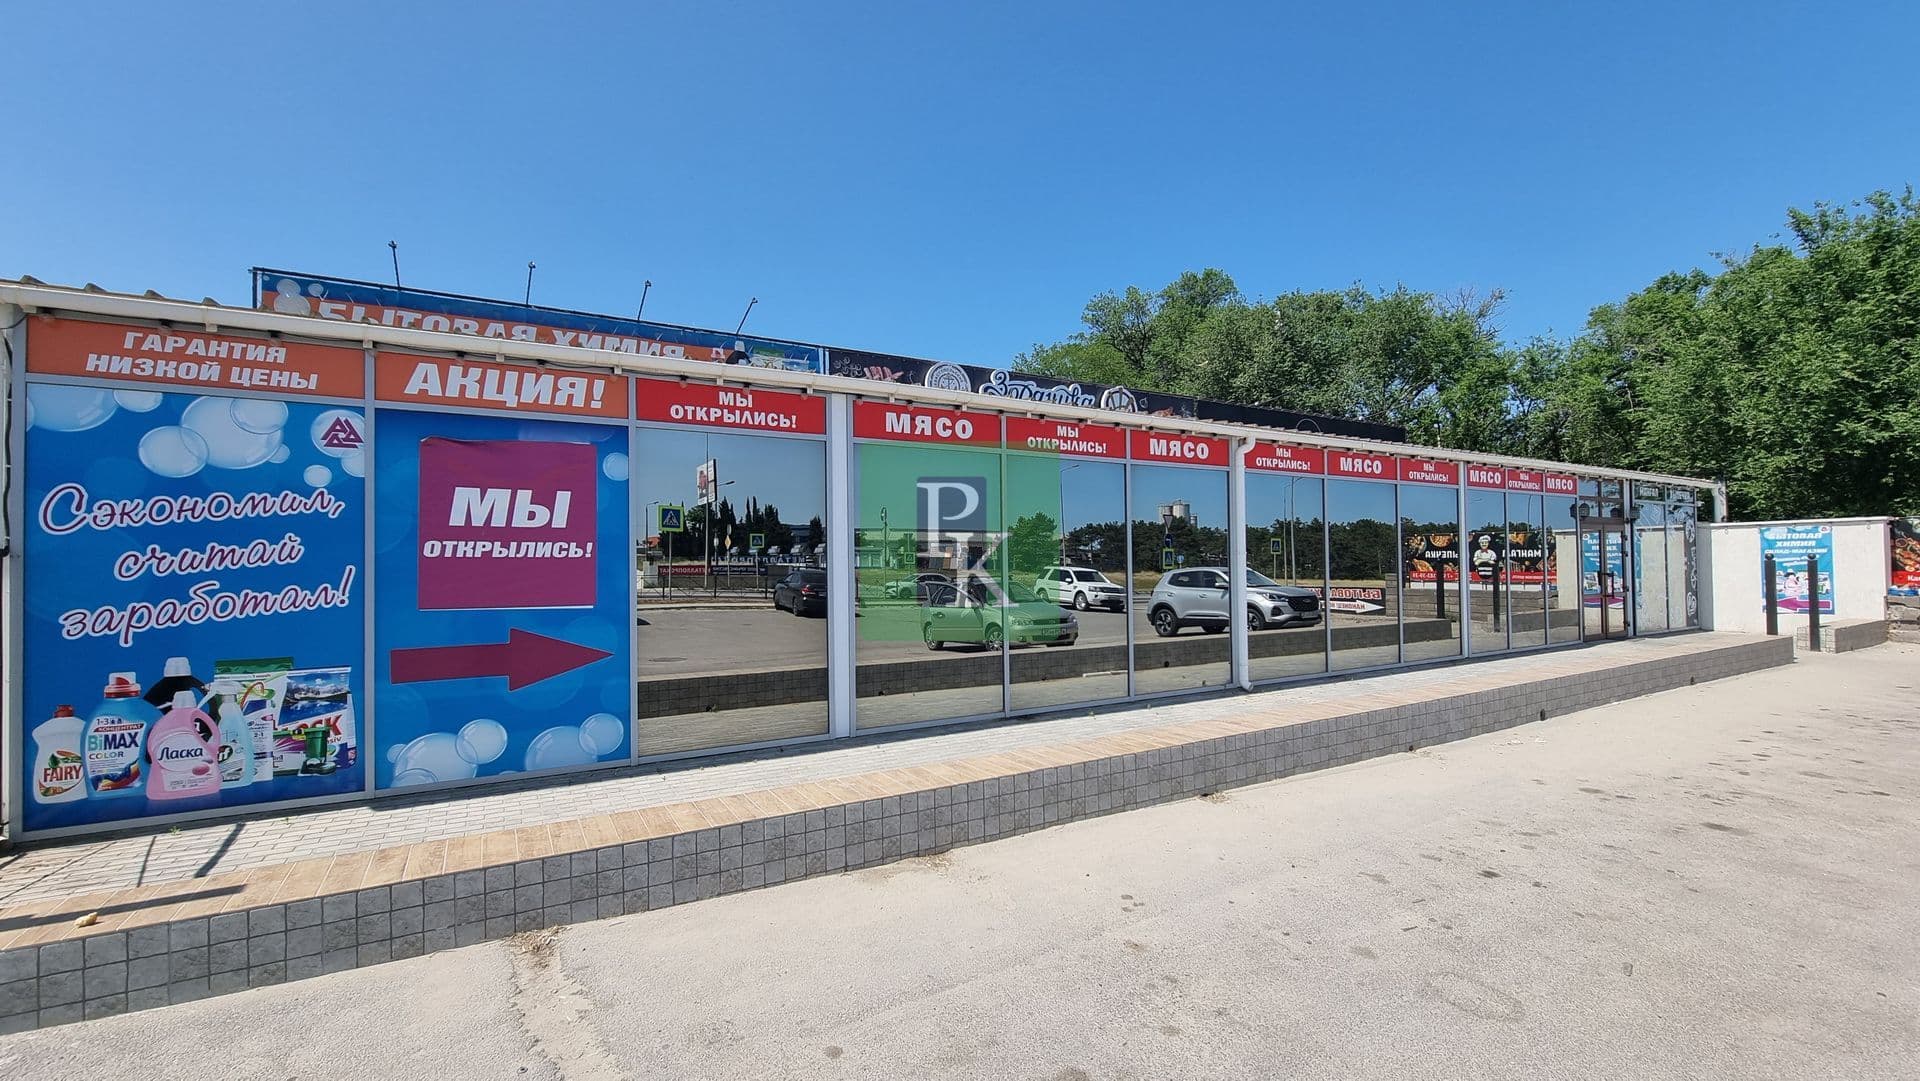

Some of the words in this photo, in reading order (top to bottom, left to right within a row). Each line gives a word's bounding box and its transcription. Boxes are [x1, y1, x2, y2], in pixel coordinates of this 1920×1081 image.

[123, 331, 287, 363] ГАРАНТИЯ
[86, 354, 221, 383] НИЗКОЙ
[230, 366, 318, 390] ЦЕНЫ
[404, 362, 606, 409] АКЦИЯ!
[719, 391, 753, 408] МЫ
[670, 404, 797, 429] ОТКРЫЛИСЬ!
[885, 412, 974, 439] МЯСО
[1057, 425, 1079, 439] МЫ
[1027, 436, 1107, 454] ОТКРЫЛИСЬ!
[1150, 438, 1209, 459] МЯСО
[1276, 447, 1291, 458] МЫ
[1256, 457, 1311, 471] ОТКРЫЛИСЬ!
[1340, 457, 1382, 474] МЯСО
[1423, 463, 1434, 472] МЫ
[1408, 471, 1449, 482] ОТКРЫЛИСЬ!
[1469, 470, 1501, 484] МЯСО
[1546, 477, 1573, 490] МЯСО
[39, 482, 345, 535] Сэкономил,
[449, 487, 572, 529] МЫ
[114, 533, 304, 580] считай
[423, 540, 593, 558] ОТКРЫЛИСЬ!
[59, 565, 356, 648] заработал!
[89, 751, 124, 760] COLOR
[158, 746, 204, 761] Ласка
[43, 765, 83, 782] FAIRY
